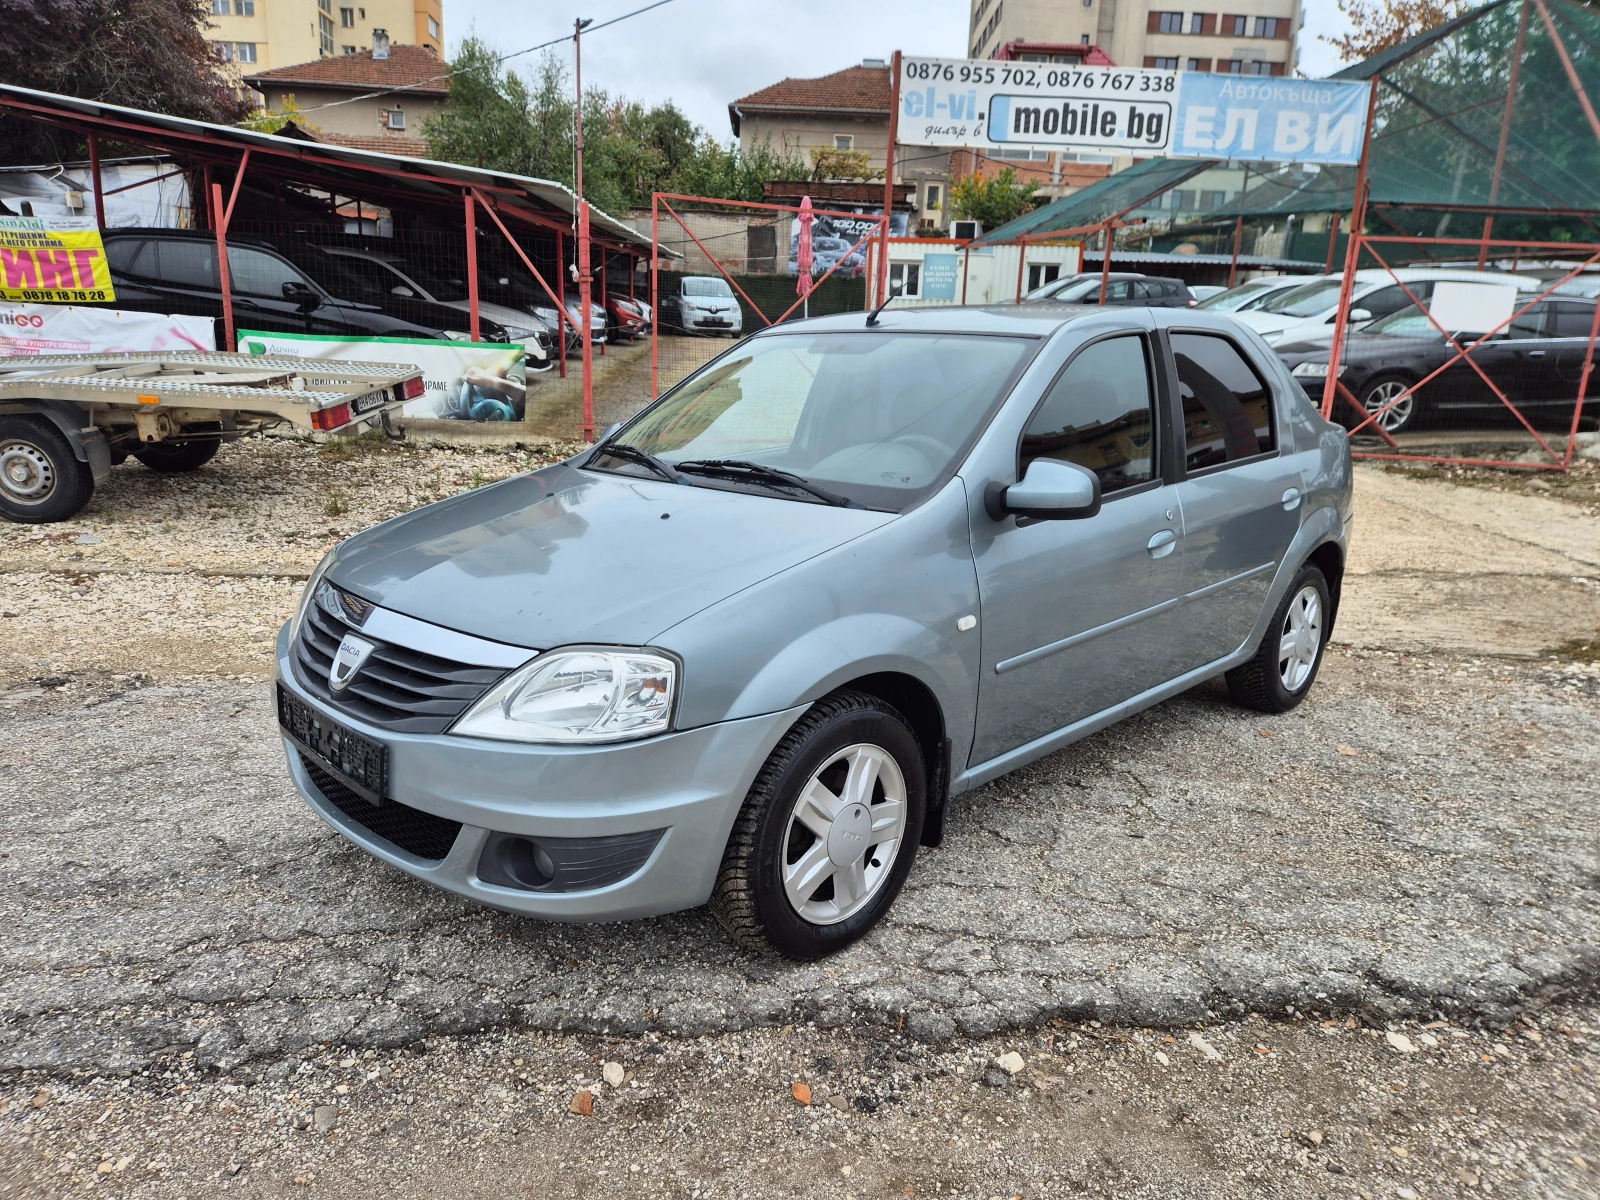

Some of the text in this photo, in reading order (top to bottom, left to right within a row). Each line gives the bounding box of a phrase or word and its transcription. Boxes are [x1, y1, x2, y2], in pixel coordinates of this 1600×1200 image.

[906, 62, 1175, 92] 0876 955 702, 0876 767 338
[1219, 79, 1333, 106] Автокъща
[1013, 102, 1164, 143] mobile.bg
[1182, 105, 1355, 154] ЕЛ ВИ
[0, 248, 99, 288] ИНГ
[341, 643, 360, 657] DACIA
